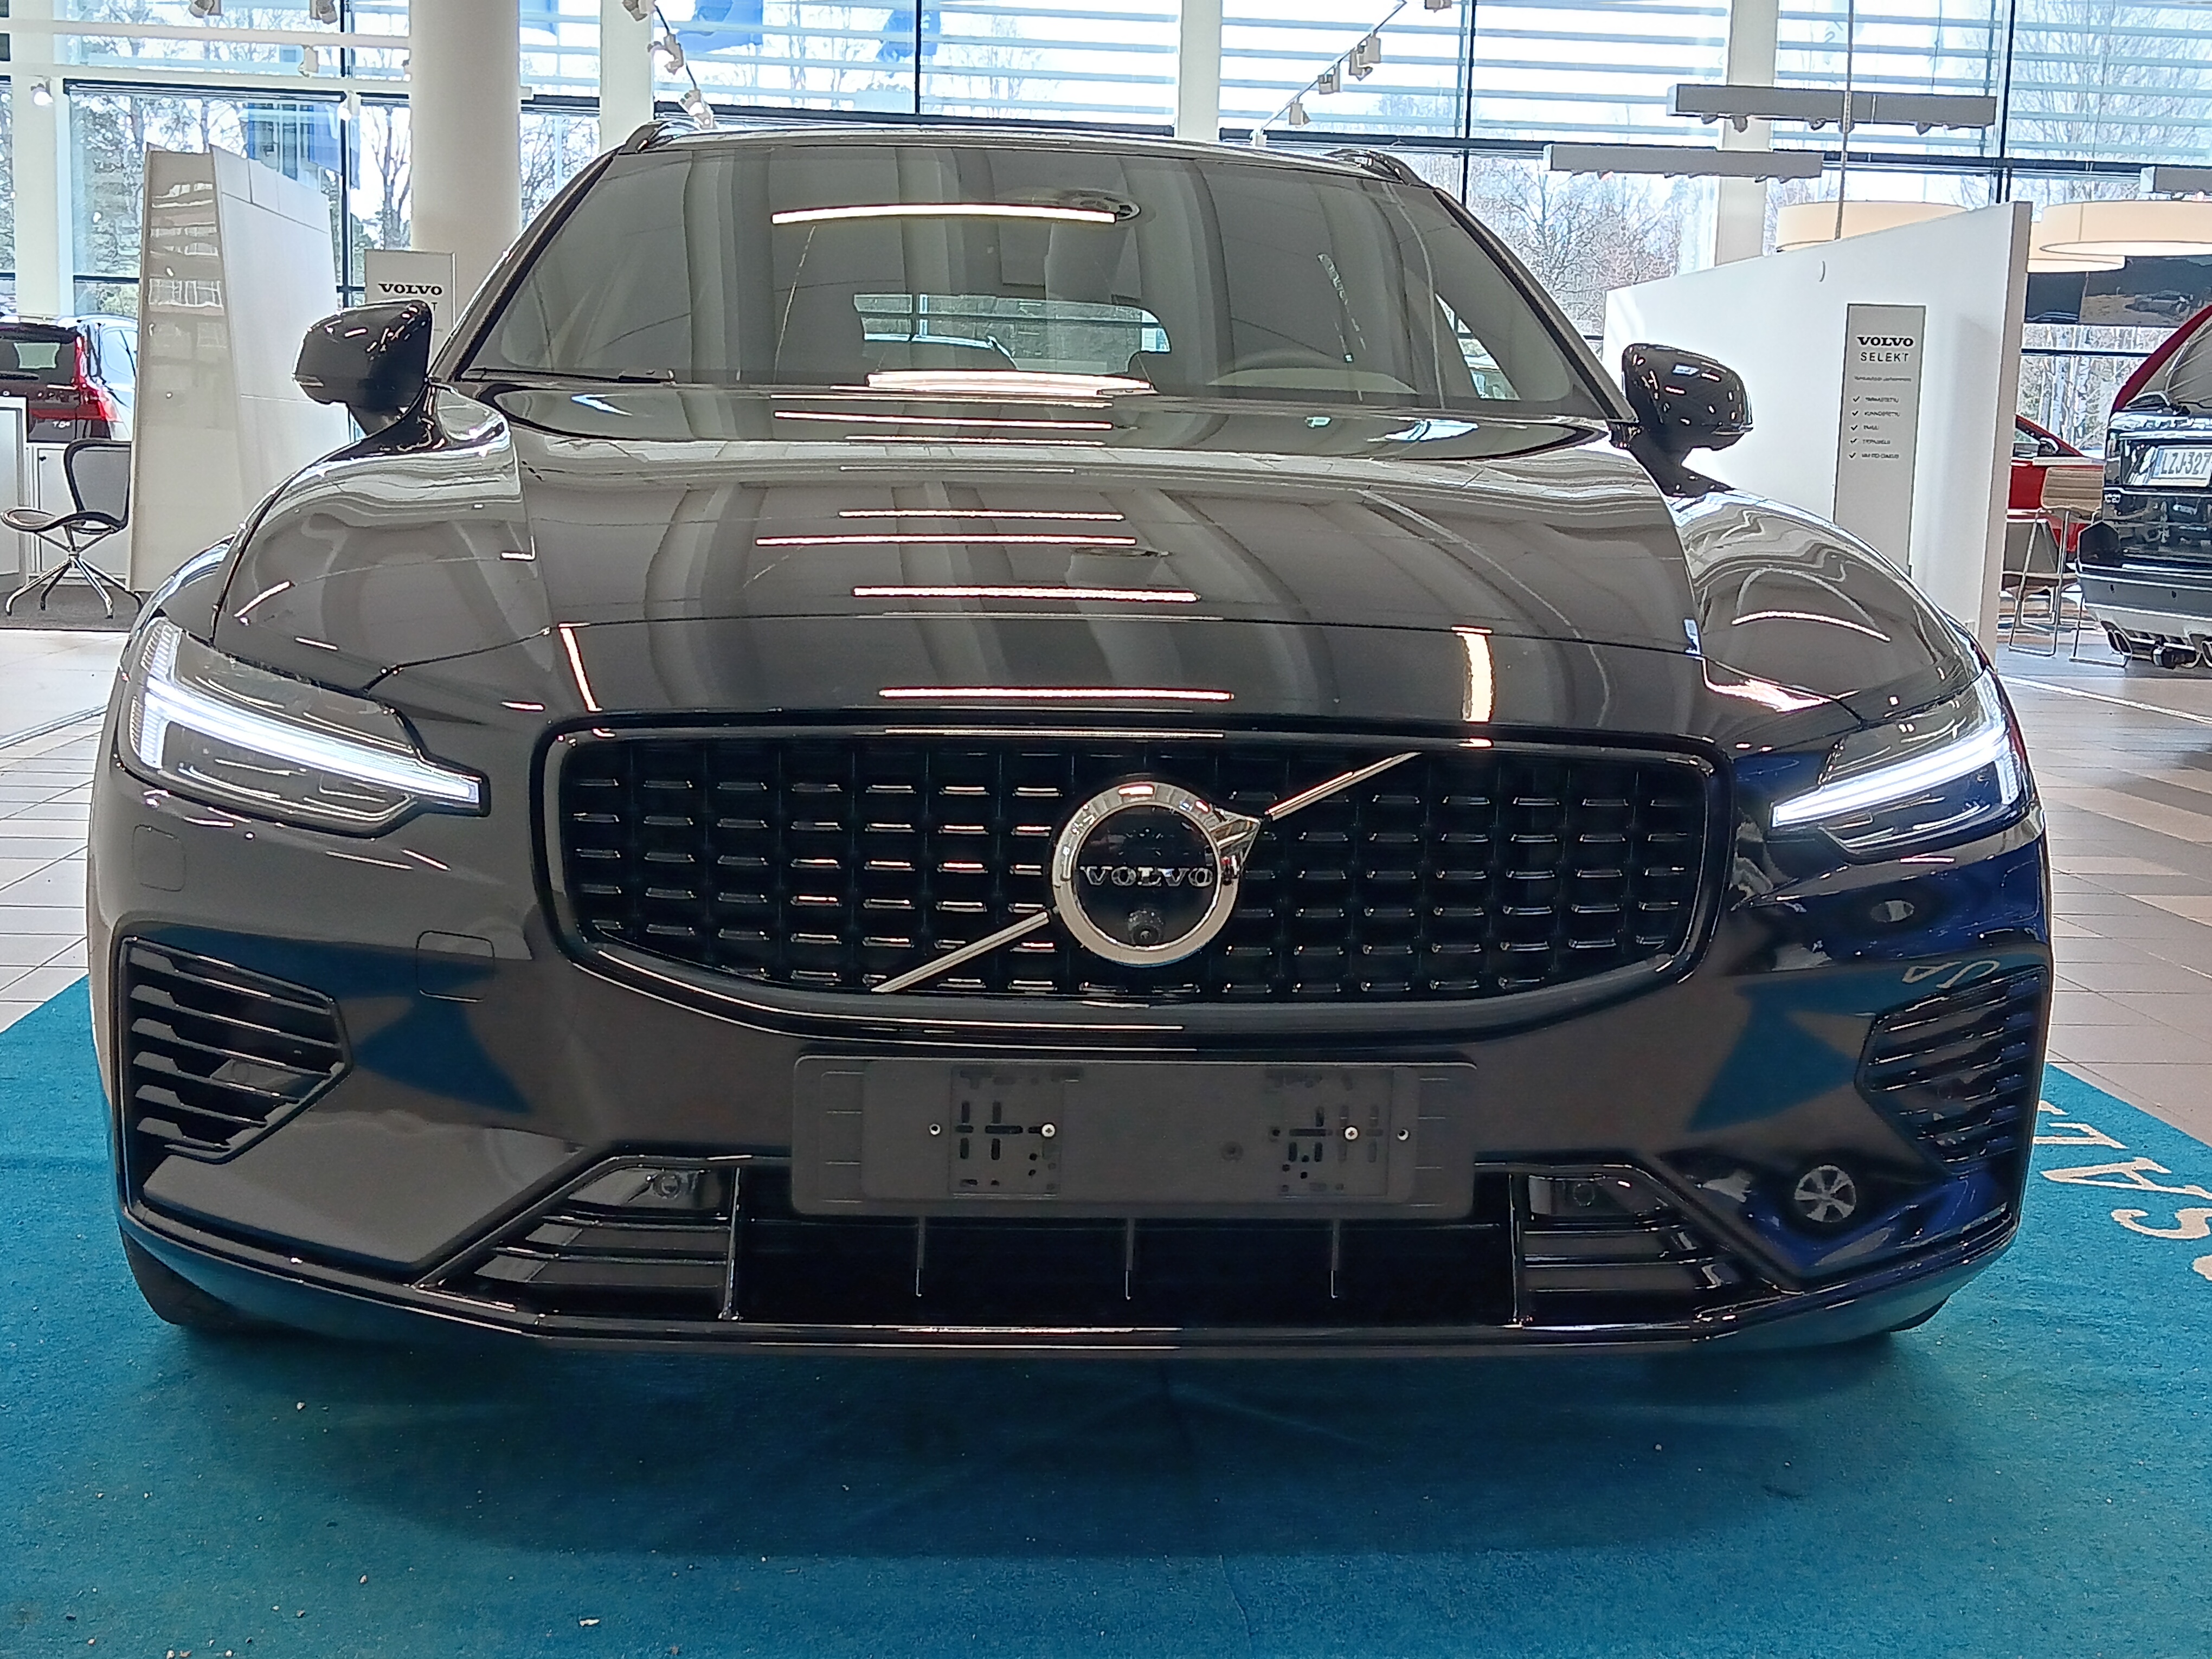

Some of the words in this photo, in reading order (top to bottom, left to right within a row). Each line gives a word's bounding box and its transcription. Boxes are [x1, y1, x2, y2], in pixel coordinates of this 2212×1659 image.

[378, 283, 442, 295] VOLVO
[1857, 337, 1914, 348] VOLVO
[1860, 351, 1909, 362] SELEKT
[1079, 865, 1214, 888] VOLVO
